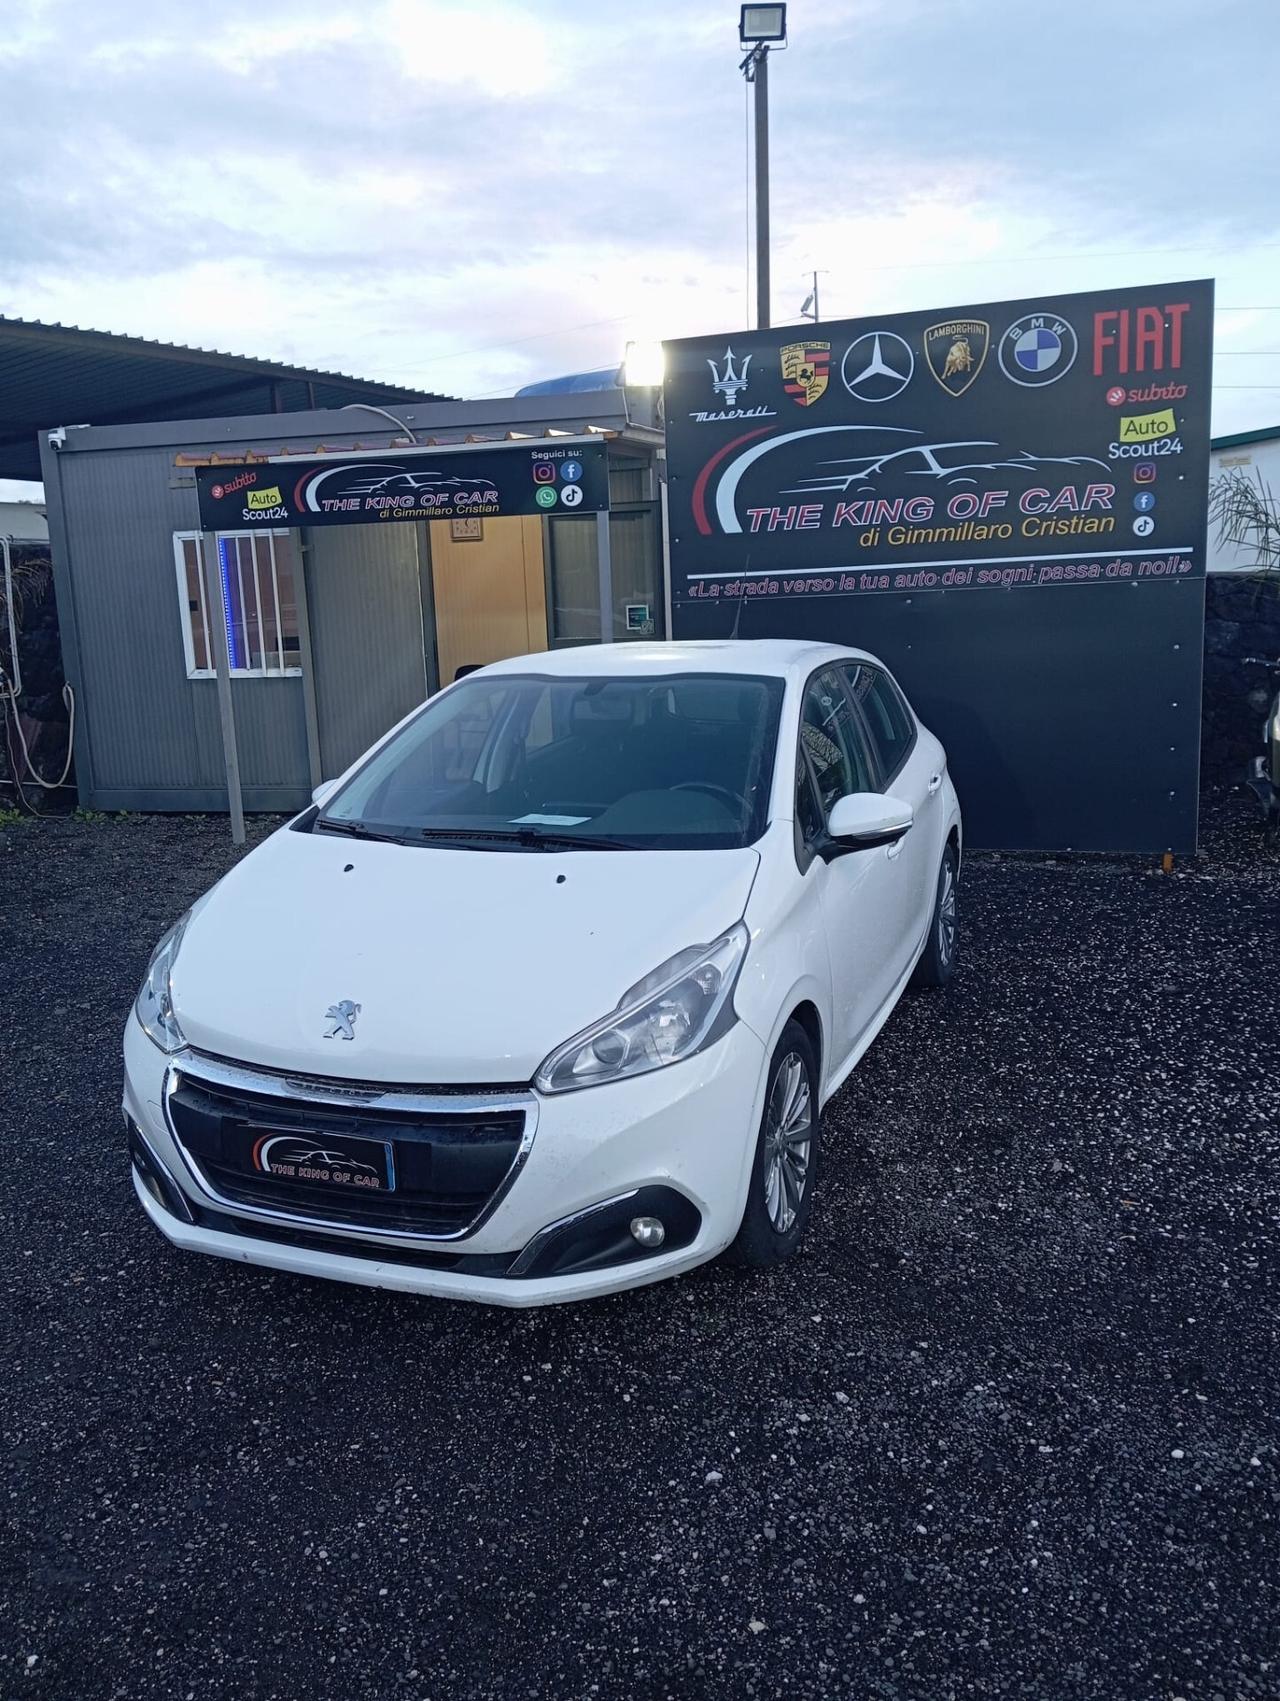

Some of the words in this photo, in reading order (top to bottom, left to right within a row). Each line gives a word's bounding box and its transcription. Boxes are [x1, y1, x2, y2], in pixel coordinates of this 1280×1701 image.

[928, 323, 985, 341] LAMBORGHINI
[1009, 317, 1067, 341] BMW
[1093, 303, 1190, 376] FIAT
[780, 341, 831, 353] PORSCHE
[1127, 381, 1188, 402] subito
[689, 405, 777, 423] Maserati
[1123, 419, 1169, 437] Auto
[531, 450, 566, 461] Seguici
[567, 449, 583, 458] su:
[1108, 437, 1183, 459] Scout24
[223, 472, 257, 494] subito
[250, 493, 278, 505] Auto
[322, 498, 361, 512] THE
[365, 495, 415, 509] KING
[420, 493, 449, 507] OF
[453, 490, 499, 505] CAR
[747, 504, 823, 533] THE
[832, 496, 935, 527] KING
[947, 490, 1009, 519] OF
[1019, 483, 1116, 514] CAR
[242, 507, 288, 521] Scout24
[379, 508, 390, 519] di
[393, 506, 453, 518] Gimmillaro
[456, 503, 500, 515] Cristian
[859, 528, 881, 547] di
[887, 522, 1013, 545] Gimmillaro
[1021, 515, 1116, 537] Cristian
[723, 577, 779, 597] strada
[783, 578, 835, 593] verso
[839, 574, 856, 591] la
[860, 573, 889, 590] tua
[894, 571, 937, 588] auto
[942, 567, 973, 585] dei
[1038, 564, 1100, 584] passa
[1105, 559, 1133, 578] da
[270, 1163, 296, 1176] THE
[298, 1167, 330, 1181] KING
[332, 1171, 351, 1183] OF
[353, 1174, 380, 1188] CAR
